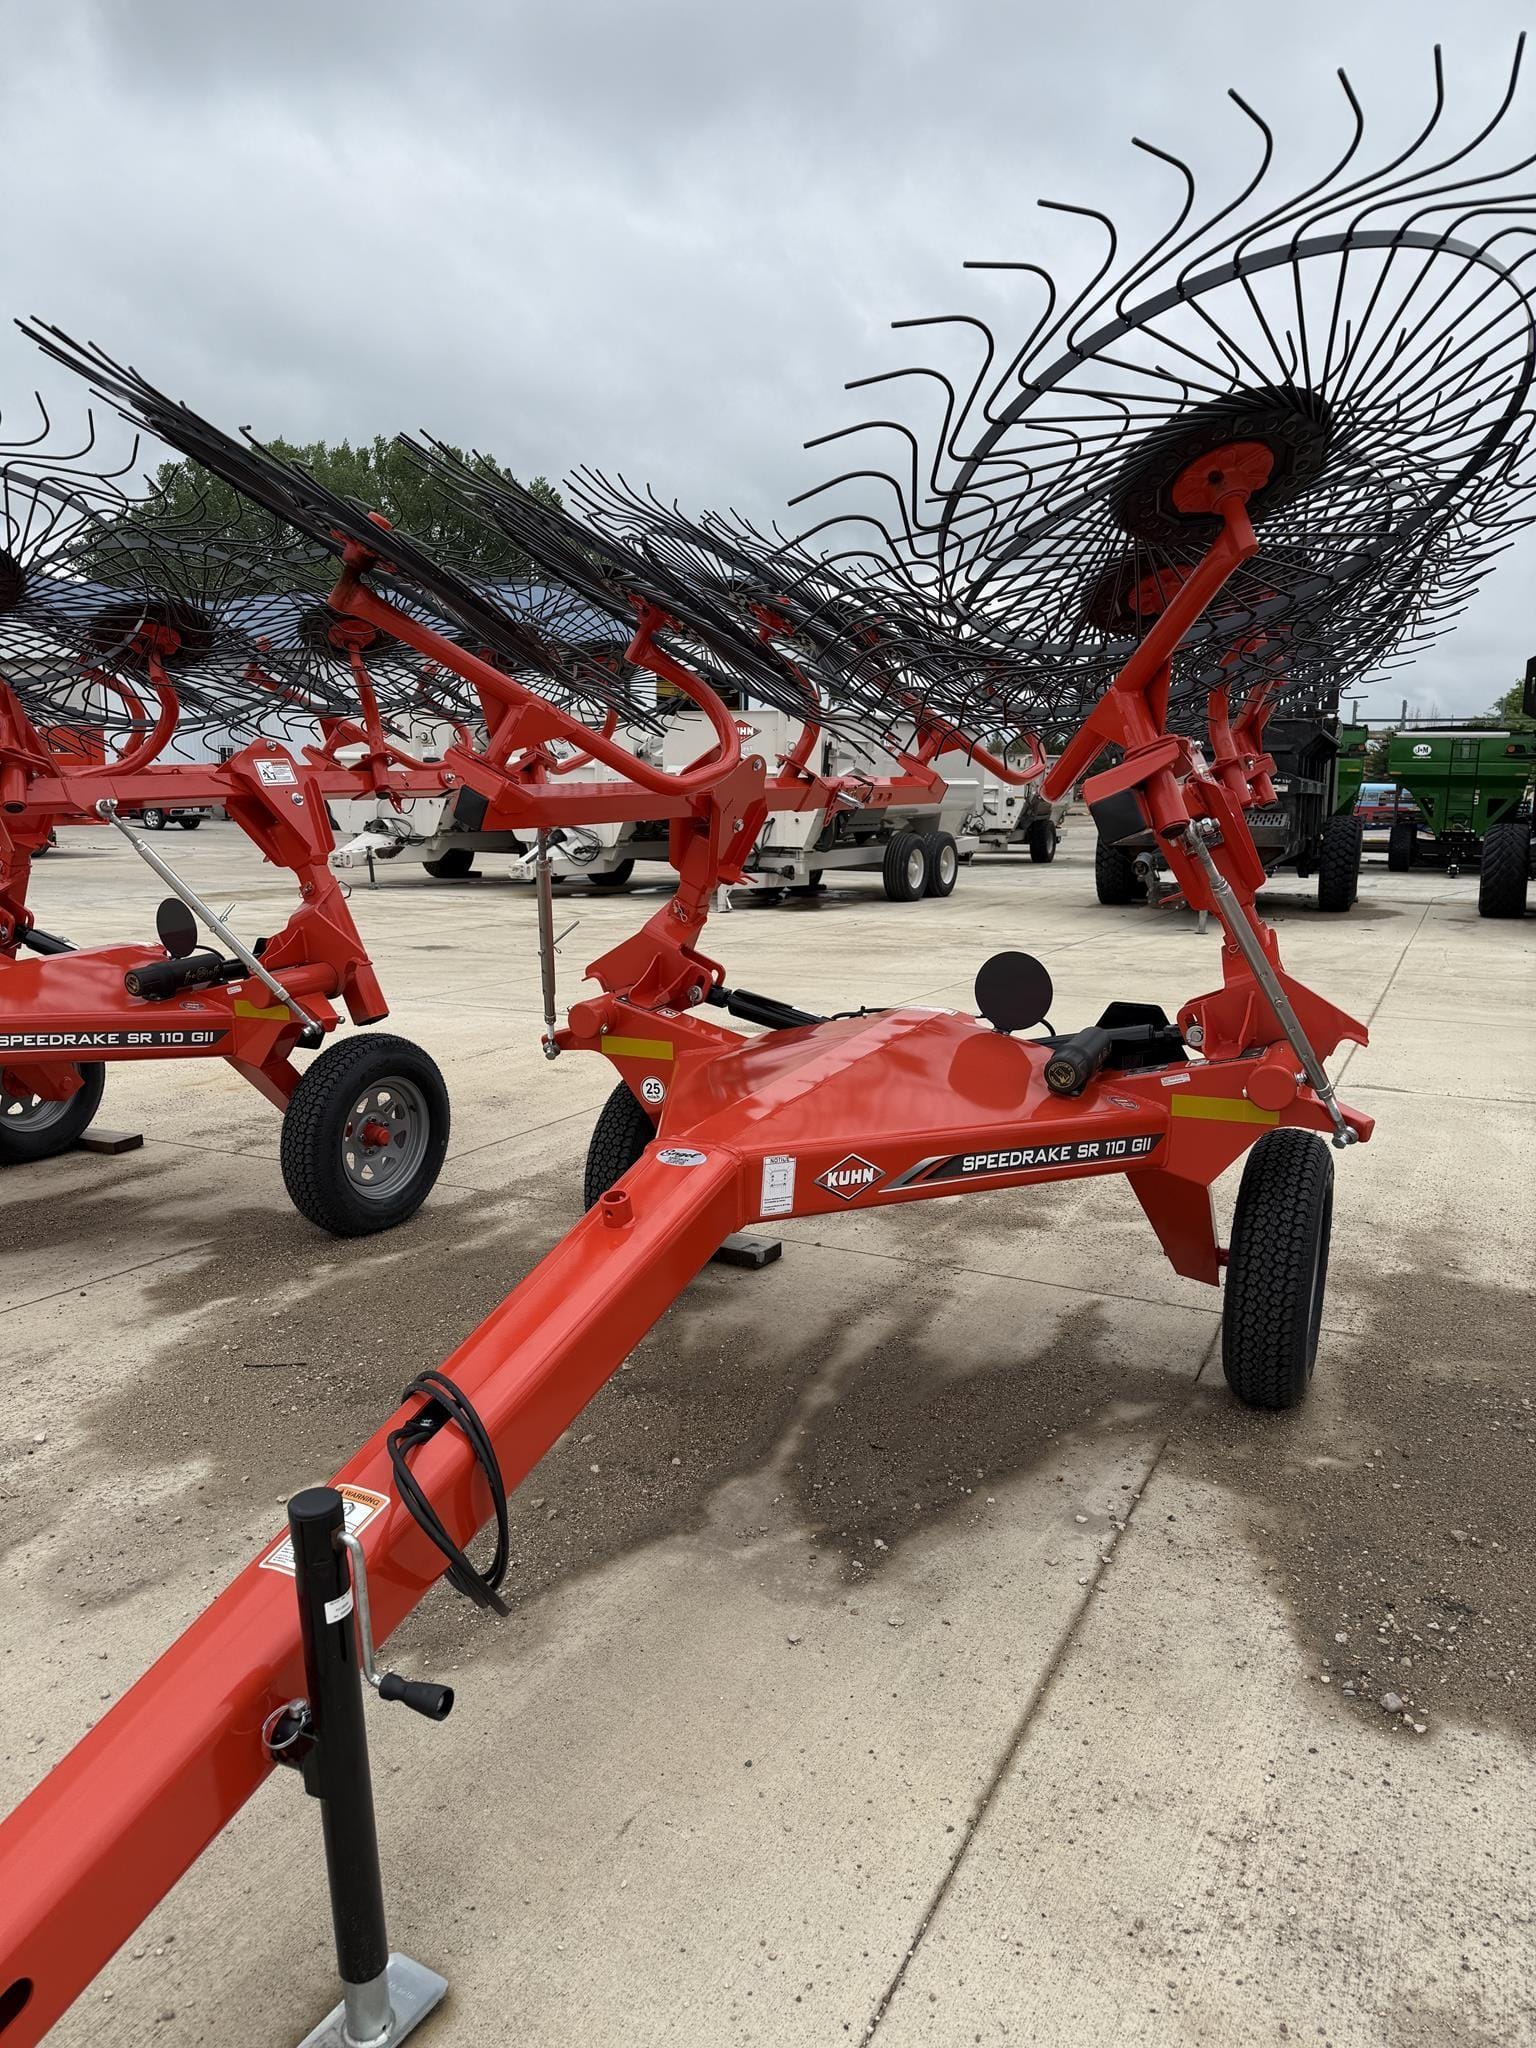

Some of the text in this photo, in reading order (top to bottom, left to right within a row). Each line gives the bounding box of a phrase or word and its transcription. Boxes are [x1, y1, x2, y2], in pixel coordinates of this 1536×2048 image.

[0, 1031, 214, 1047] SPEEDRAKE SR 110 GII
[645, 1082, 661, 1095] 25
[962, 1137, 1152, 1172] SPEEDRAKE SR 110 GII
[827, 1167, 874, 1187] KUHN
[345, 1489, 380, 1506] WARNING
